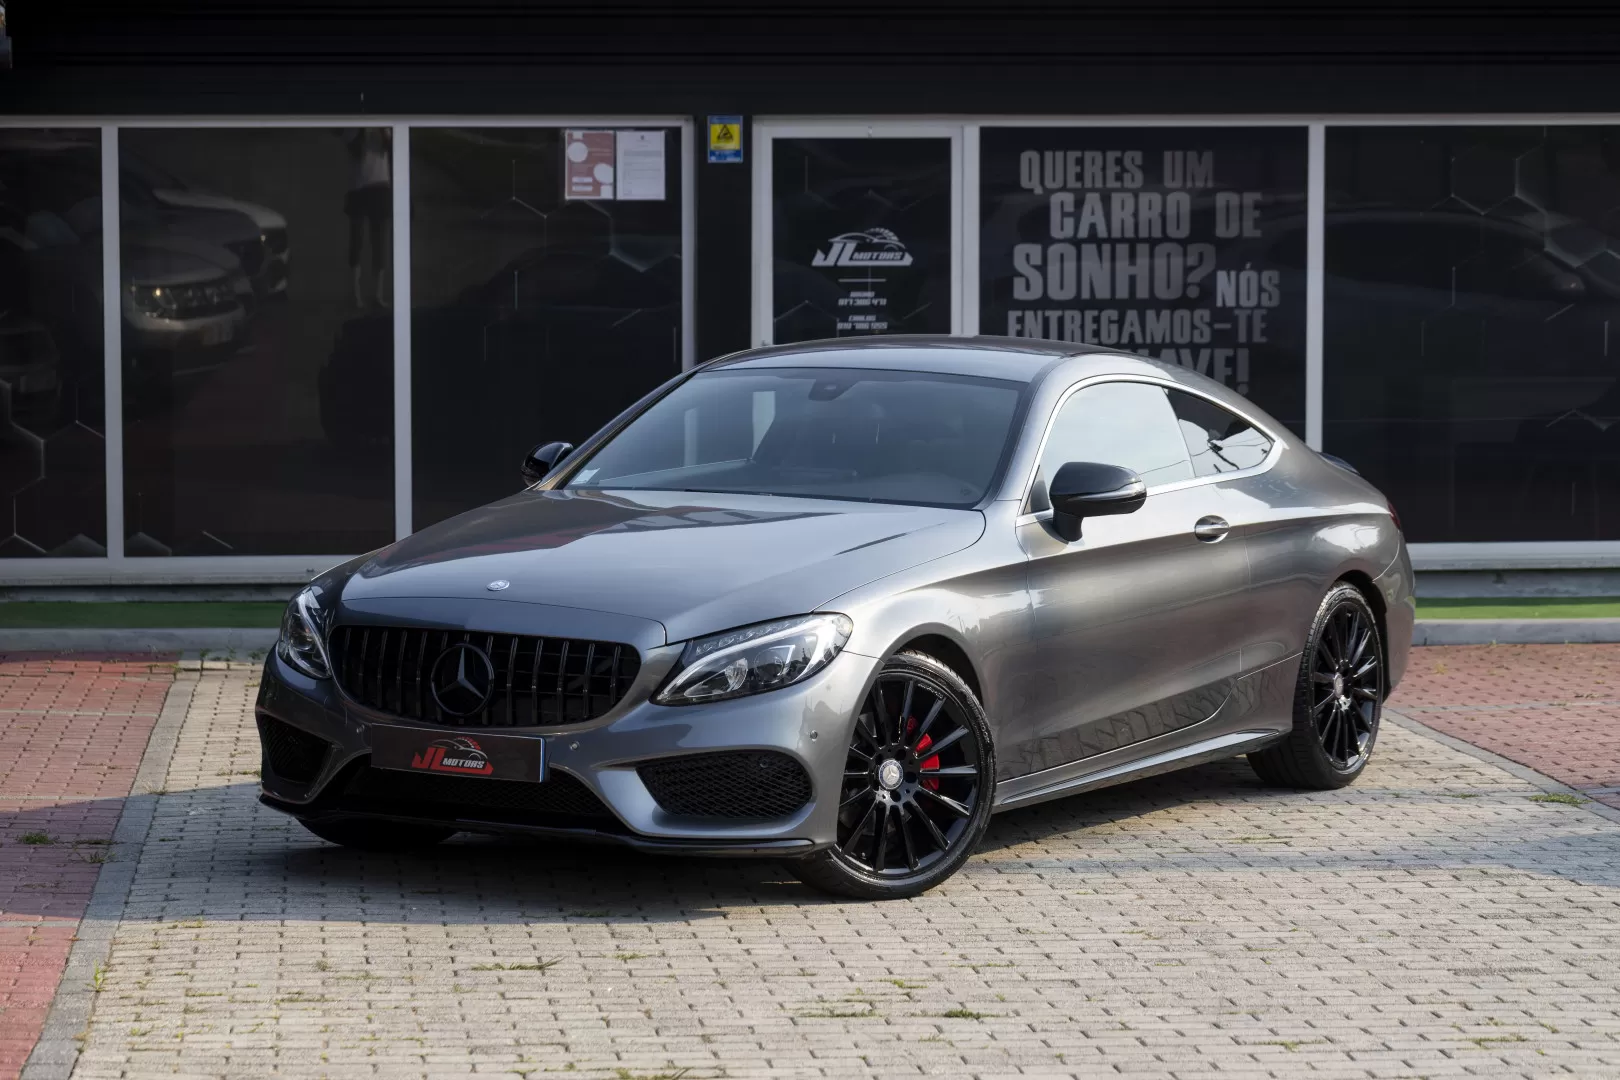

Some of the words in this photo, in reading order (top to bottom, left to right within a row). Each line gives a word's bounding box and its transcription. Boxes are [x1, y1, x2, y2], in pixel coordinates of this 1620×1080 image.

[1019, 150, 1144, 195] QUERES
[1163, 150, 1214, 189] UM
[1049, 191, 1191, 239] CARRO
[1215, 191, 1262, 238] DE
[851, 251, 903, 261] MOTORS
[1012, 243, 1217, 300] SONHO?
[1215, 262, 1281, 308] NÓS
[1007, 308, 1268, 344] ENTREGAMOS-TE
[442, 757, 485, 769] MOTORS
